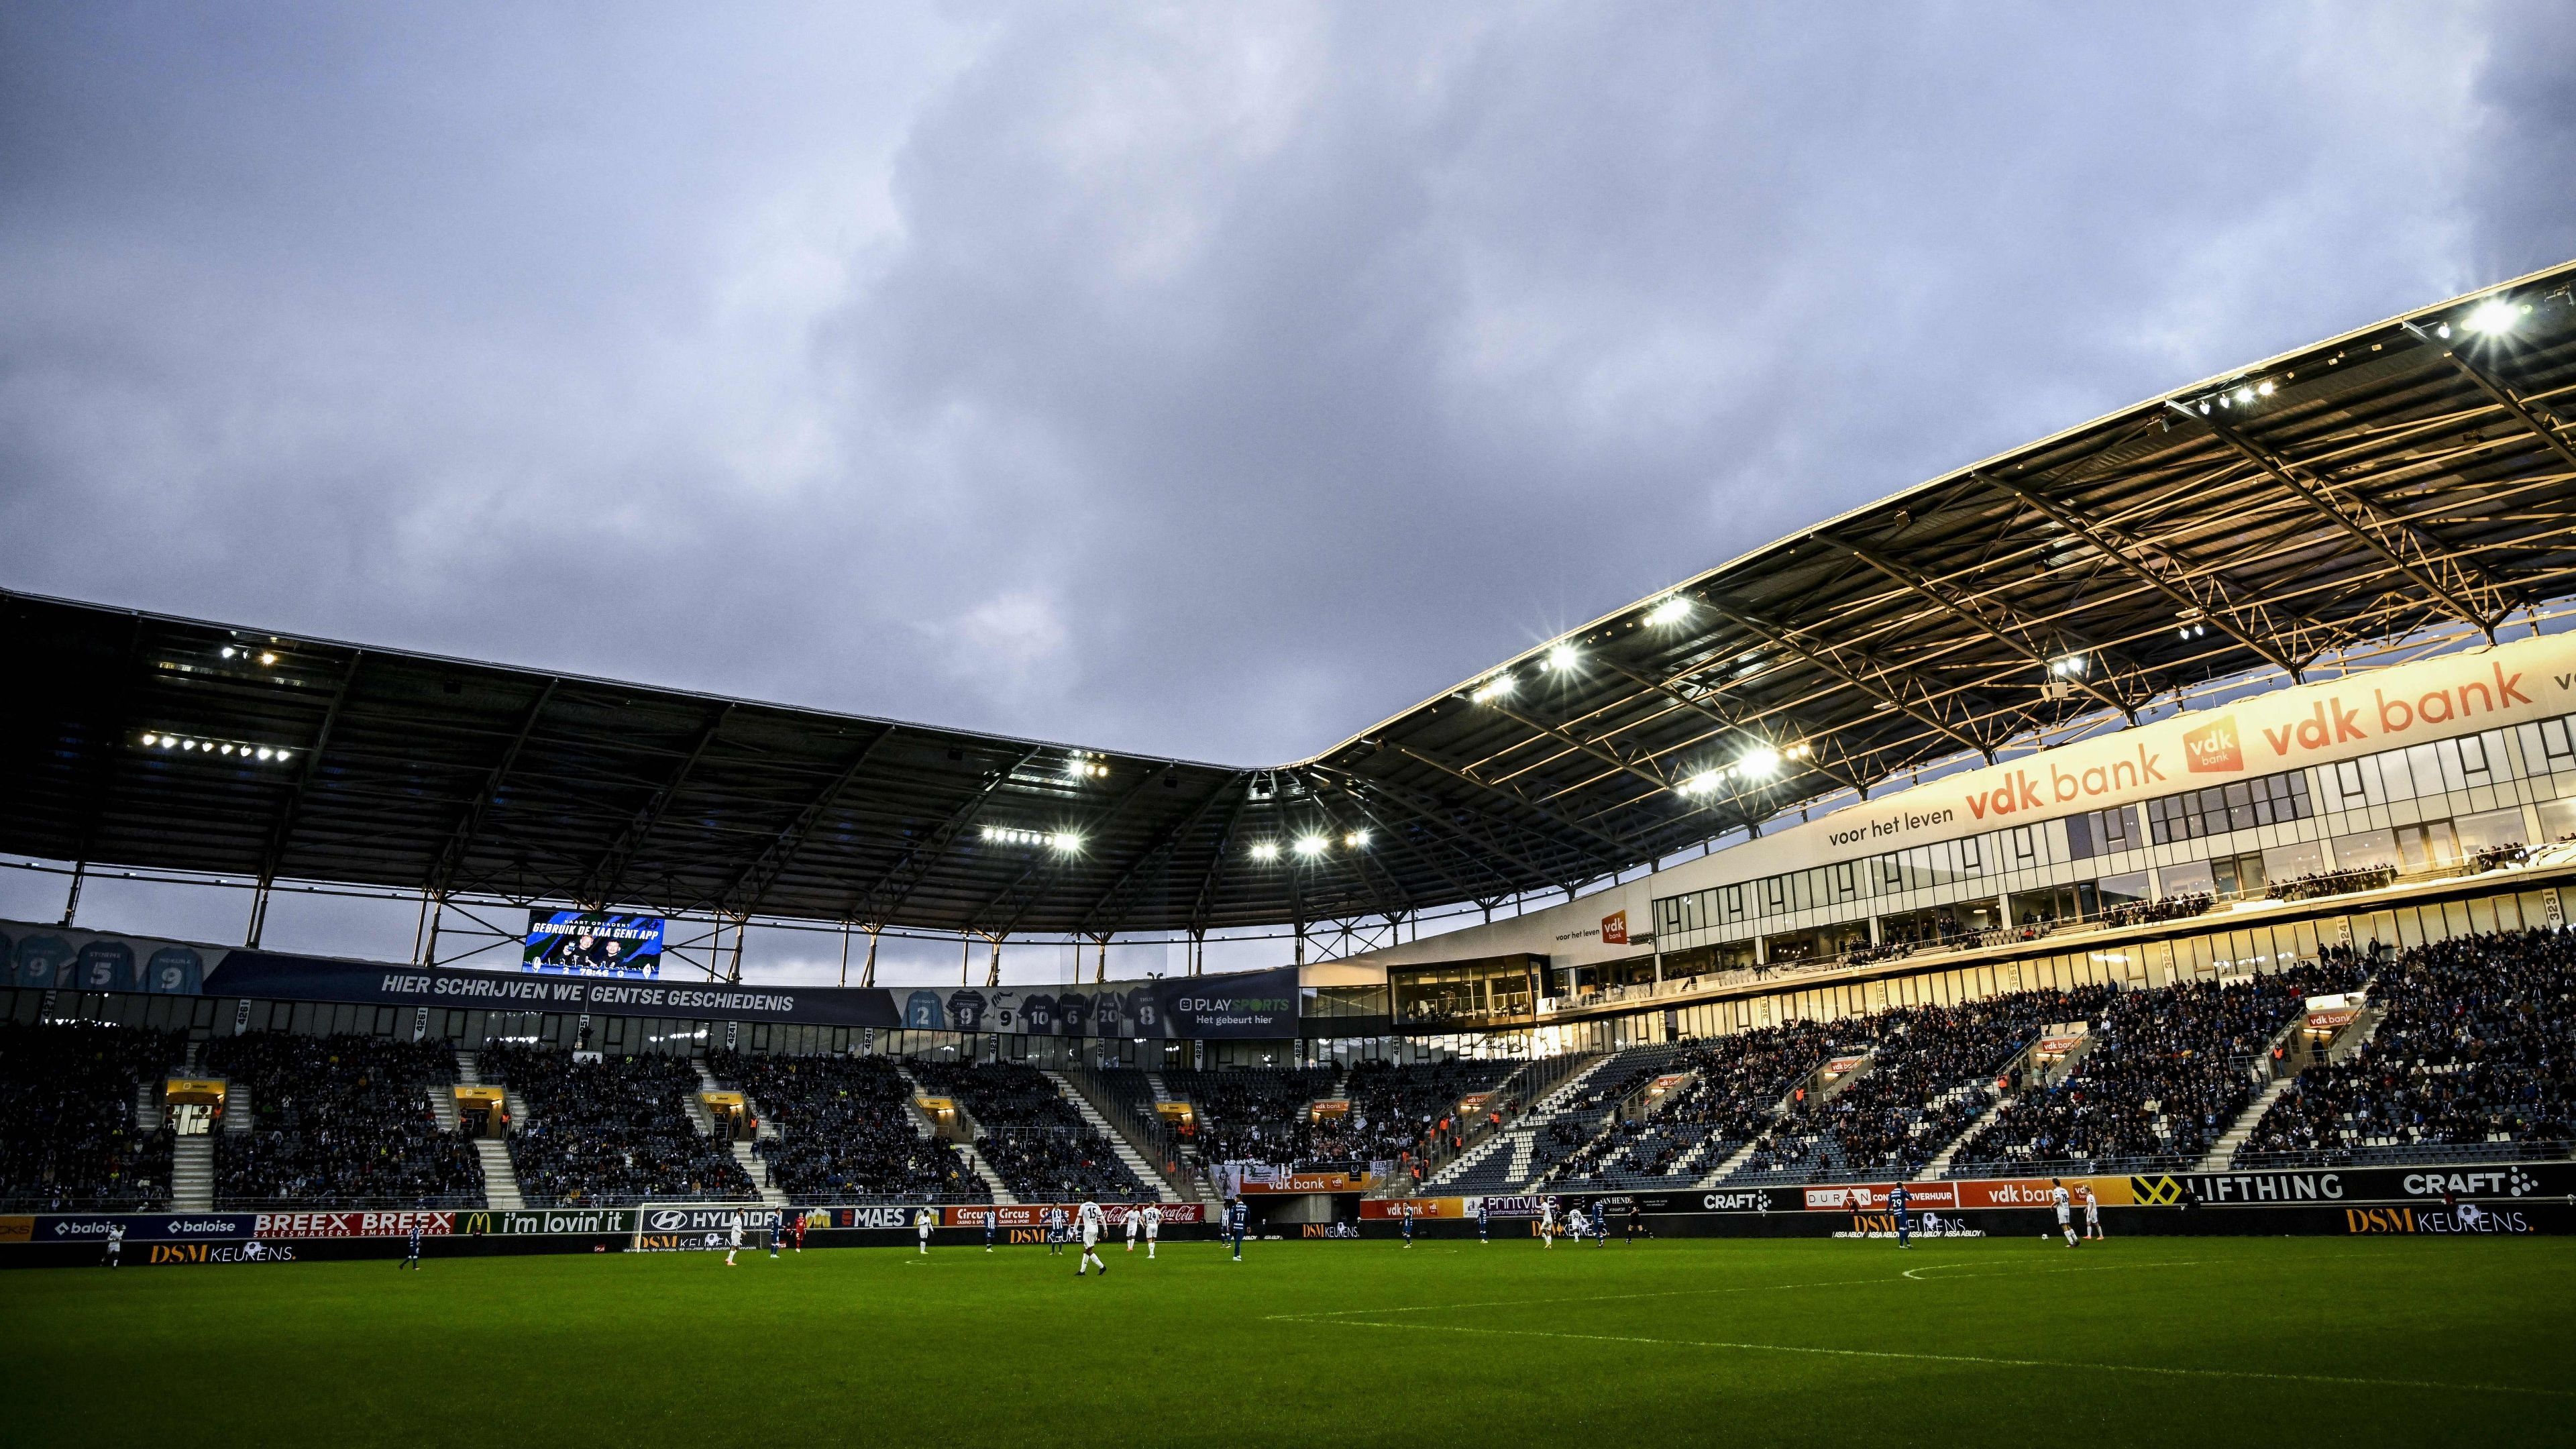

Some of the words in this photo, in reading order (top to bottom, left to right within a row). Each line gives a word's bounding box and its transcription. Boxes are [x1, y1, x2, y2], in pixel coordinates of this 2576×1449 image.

[2262, 696, 2369, 757] vdk
[2374, 661, 2533, 734] bank
[2190, 729, 2235, 755] vdk
[2202, 751, 2229, 766] bank
[1966, 769, 2045, 820] vdk
[2051, 743, 2167, 804] bank
[1829, 826, 1868, 847] voor
[1871, 818, 1900, 839] het
[1904, 808, 1953, 831] leven
[2546, 897, 2560, 920] 323
[533, 922, 574, 935] GEBRUIK
[577, 926, 590, 936] DE
[592, 927, 610, 938] KAA
[613, 928, 639, 939] GENT
[639, 930, 659, 941] APP
[1572, 930, 1582, 938] het
[1583, 928, 1600, 938] leven
[1604, 917, 1624, 933] vdk
[91, 962, 112, 985] 5
[162, 967, 182, 989] 9
[382, 975, 430, 994] HIER
[434, 978, 549, 1000] SCHRIJVEN
[553, 983, 582, 1001] WE
[590, 986, 665, 1005] GENTSE
[668, 989, 794, 1011] GESCHIEDENIS
[237, 1006, 248, 1025] 426
[415, 1014, 427, 1032] 426
[917, 1006, 929, 1025] 2
[961, 1008, 973, 1025] 9
[1000, 1010, 1012, 1026] 9
[1031, 1011, 1049, 1025] 10
[1067, 1010, 1078, 1024] 6
[1099, 1010, 1118, 1022] 20
[1140, 1006, 1155, 1025] 8
[1197, 1015, 1213, 1024] Het
[1216, 1015, 1252, 1026] gebeurt
[1255, 1015, 1273, 1024] hier
[2311, 1016, 2327, 1025] vdk
[2328, 1014, 2351, 1024] bank
[2044, 1042, 2057, 1050] vdk
[1268, 1177, 1291, 1190] vdk
[1294, 1177, 1325, 1190] bank
[2187, 1174, 2343, 1201] LIFTHING
[2404, 1173, 2506, 1195] CRAFT
[1703, 1193, 1756, 1210] CRAFT
[1988, 1185, 2020, 1203] vdk
[2022, 1185, 2055, 1202] ban
[1387, 1203, 1402, 1216] vdk
[1403, 1202, 1423, 1215] bnk
[1489, 1196, 1557, 1210] PRINTVILE
[1892, 1199, 1902, 1208] 29
[362, 1212, 453, 1230] BREEX
[692, 1212, 783, 1228] HYUNDAI
[854, 1208, 905, 1227] MAES
[999, 1208, 1030, 1219] Circus
[1088, 1207, 1096, 1219] 15
[1148, 1212, 1156, 1220] 24
[1236, 1212, 1245, 1221] 11
[2346, 1208, 2415, 1233] DSM
[182, 1220, 235, 1233] baloise
[255, 1214, 351, 1232] BREEX
[503, 1212, 537, 1233] i'm
[544, 1212, 603, 1233] lovin'
[607, 1212, 622, 1232] it
[1303, 1224, 1324, 1238] DSM
[1853, 1214, 1896, 1233] DSM
[253, 1230, 351, 1238] SALESMAKERS
[633, 1236, 679, 1248] DSM
[1010, 1228, 1045, 1244] DSM
[150, 1244, 208, 1264] DSM
